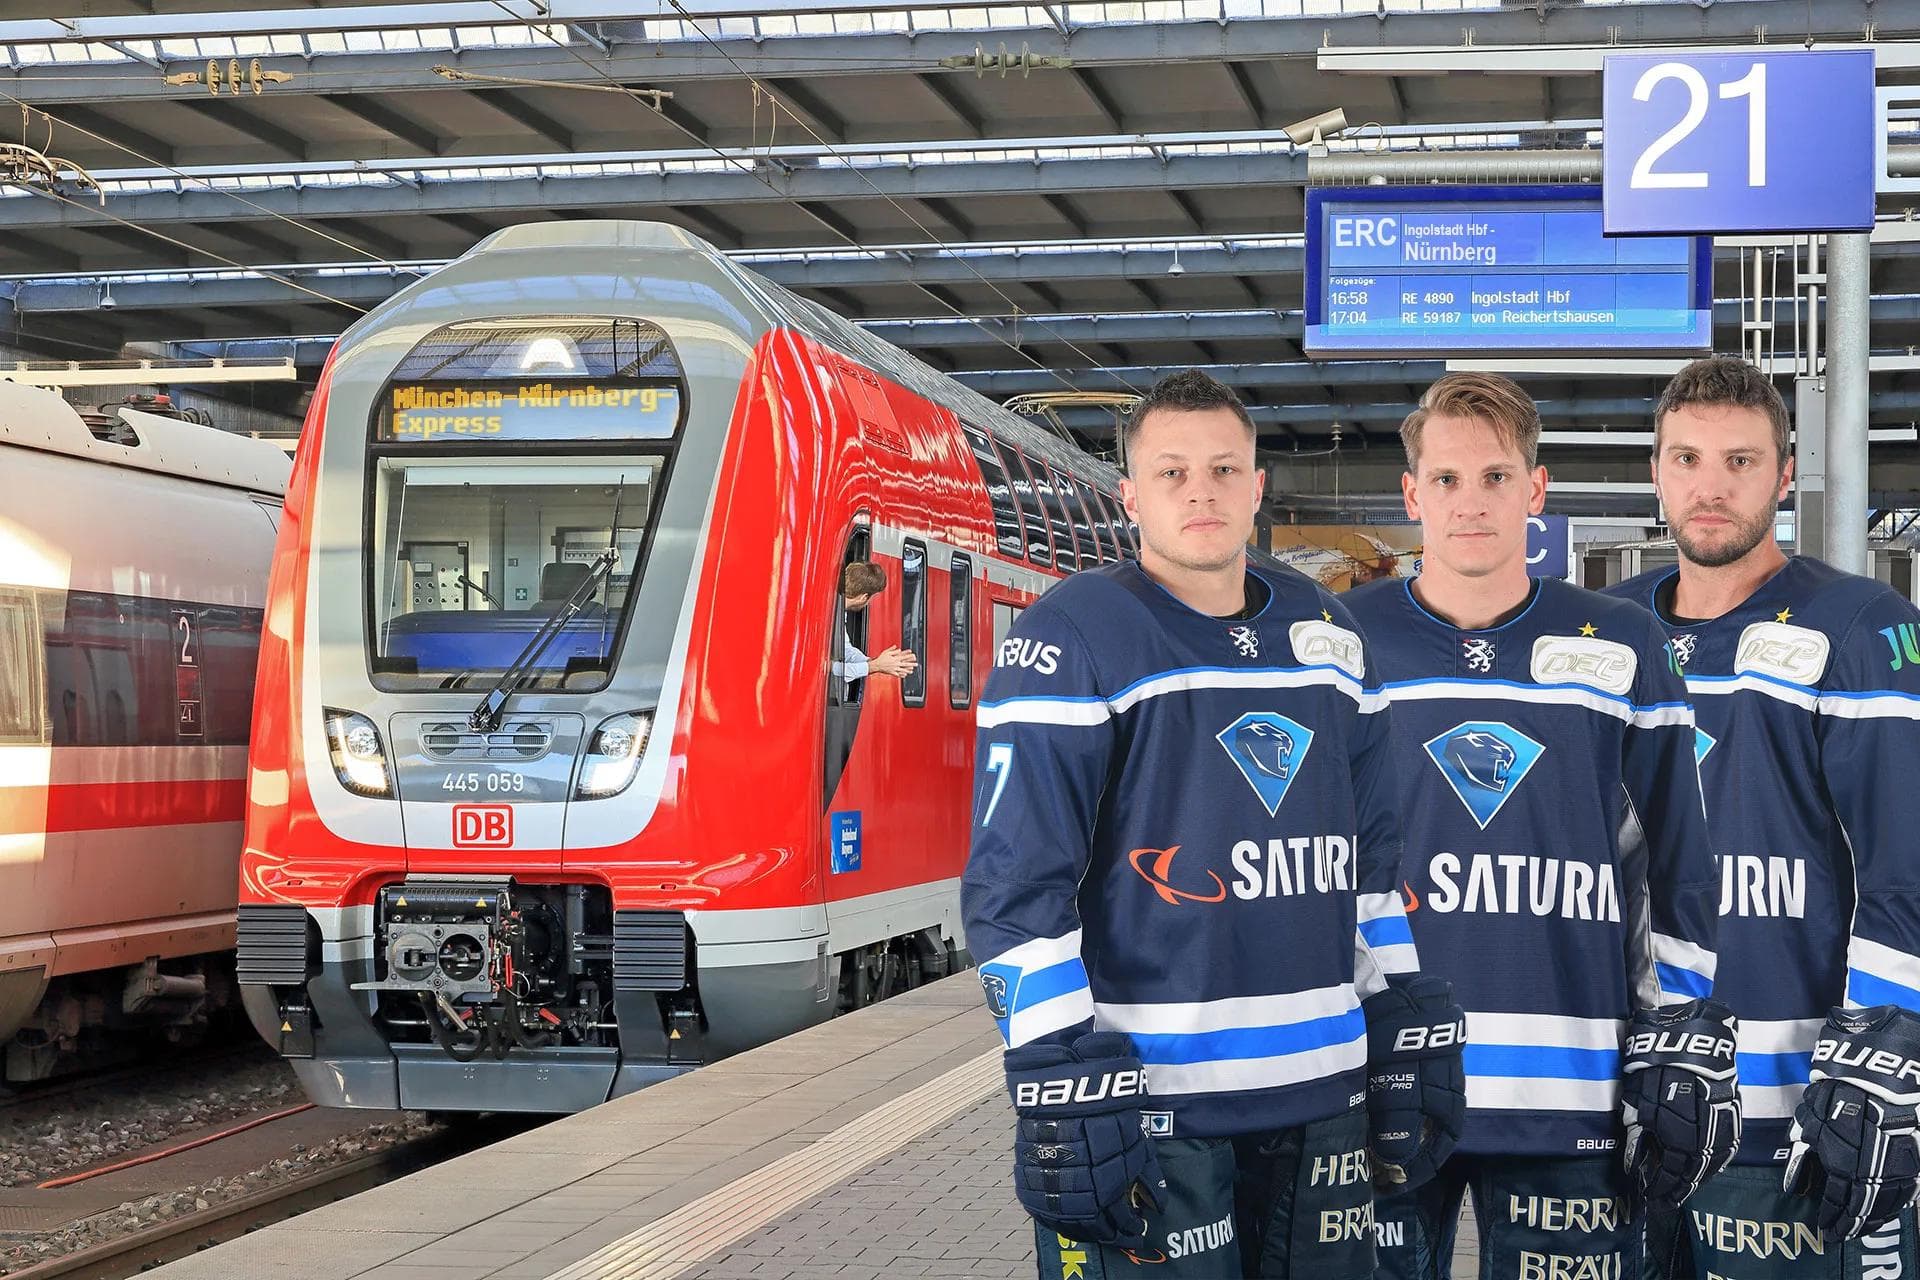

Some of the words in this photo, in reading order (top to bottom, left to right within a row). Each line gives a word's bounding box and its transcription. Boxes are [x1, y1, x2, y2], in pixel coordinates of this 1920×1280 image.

[1630, 62, 1767, 189] 21
[1335, 218, 1397, 247] ERC
[1404, 224, 1464, 239] Ingolstadt
[1467, 224, 1488, 236] Hbf
[1405, 242, 1496, 265] Nürnberg
[1331, 292, 1368, 305] 16:58
[1402, 293, 1418, 304] RE
[1424, 293, 1454, 304] 4890
[1472, 291, 1540, 307] Ingolstadt
[1547, 290, 1571, 304] Hbf
[1331, 311, 1367, 324] 17:04
[1402, 312, 1418, 323] RE
[1424, 312, 1461, 323] 59187
[1472, 312, 1496, 323] von
[1503, 310, 1614, 323] Reichertshausen
[392, 412, 502, 439] Express
[179, 615, 193, 663] 2
[1878, 622, 1920, 672] JU
[993, 637, 1062, 675] RBUS
[442, 772, 479, 792] 445
[487, 772, 524, 792] 059
[460, 811, 507, 841] DB
[1811, 1039, 1920, 1085] AUER
[1577, 1138, 1618, 1150] BAUE
[1311, 1148, 1373, 1187] HER
[1692, 1210, 1825, 1261] HERRN
